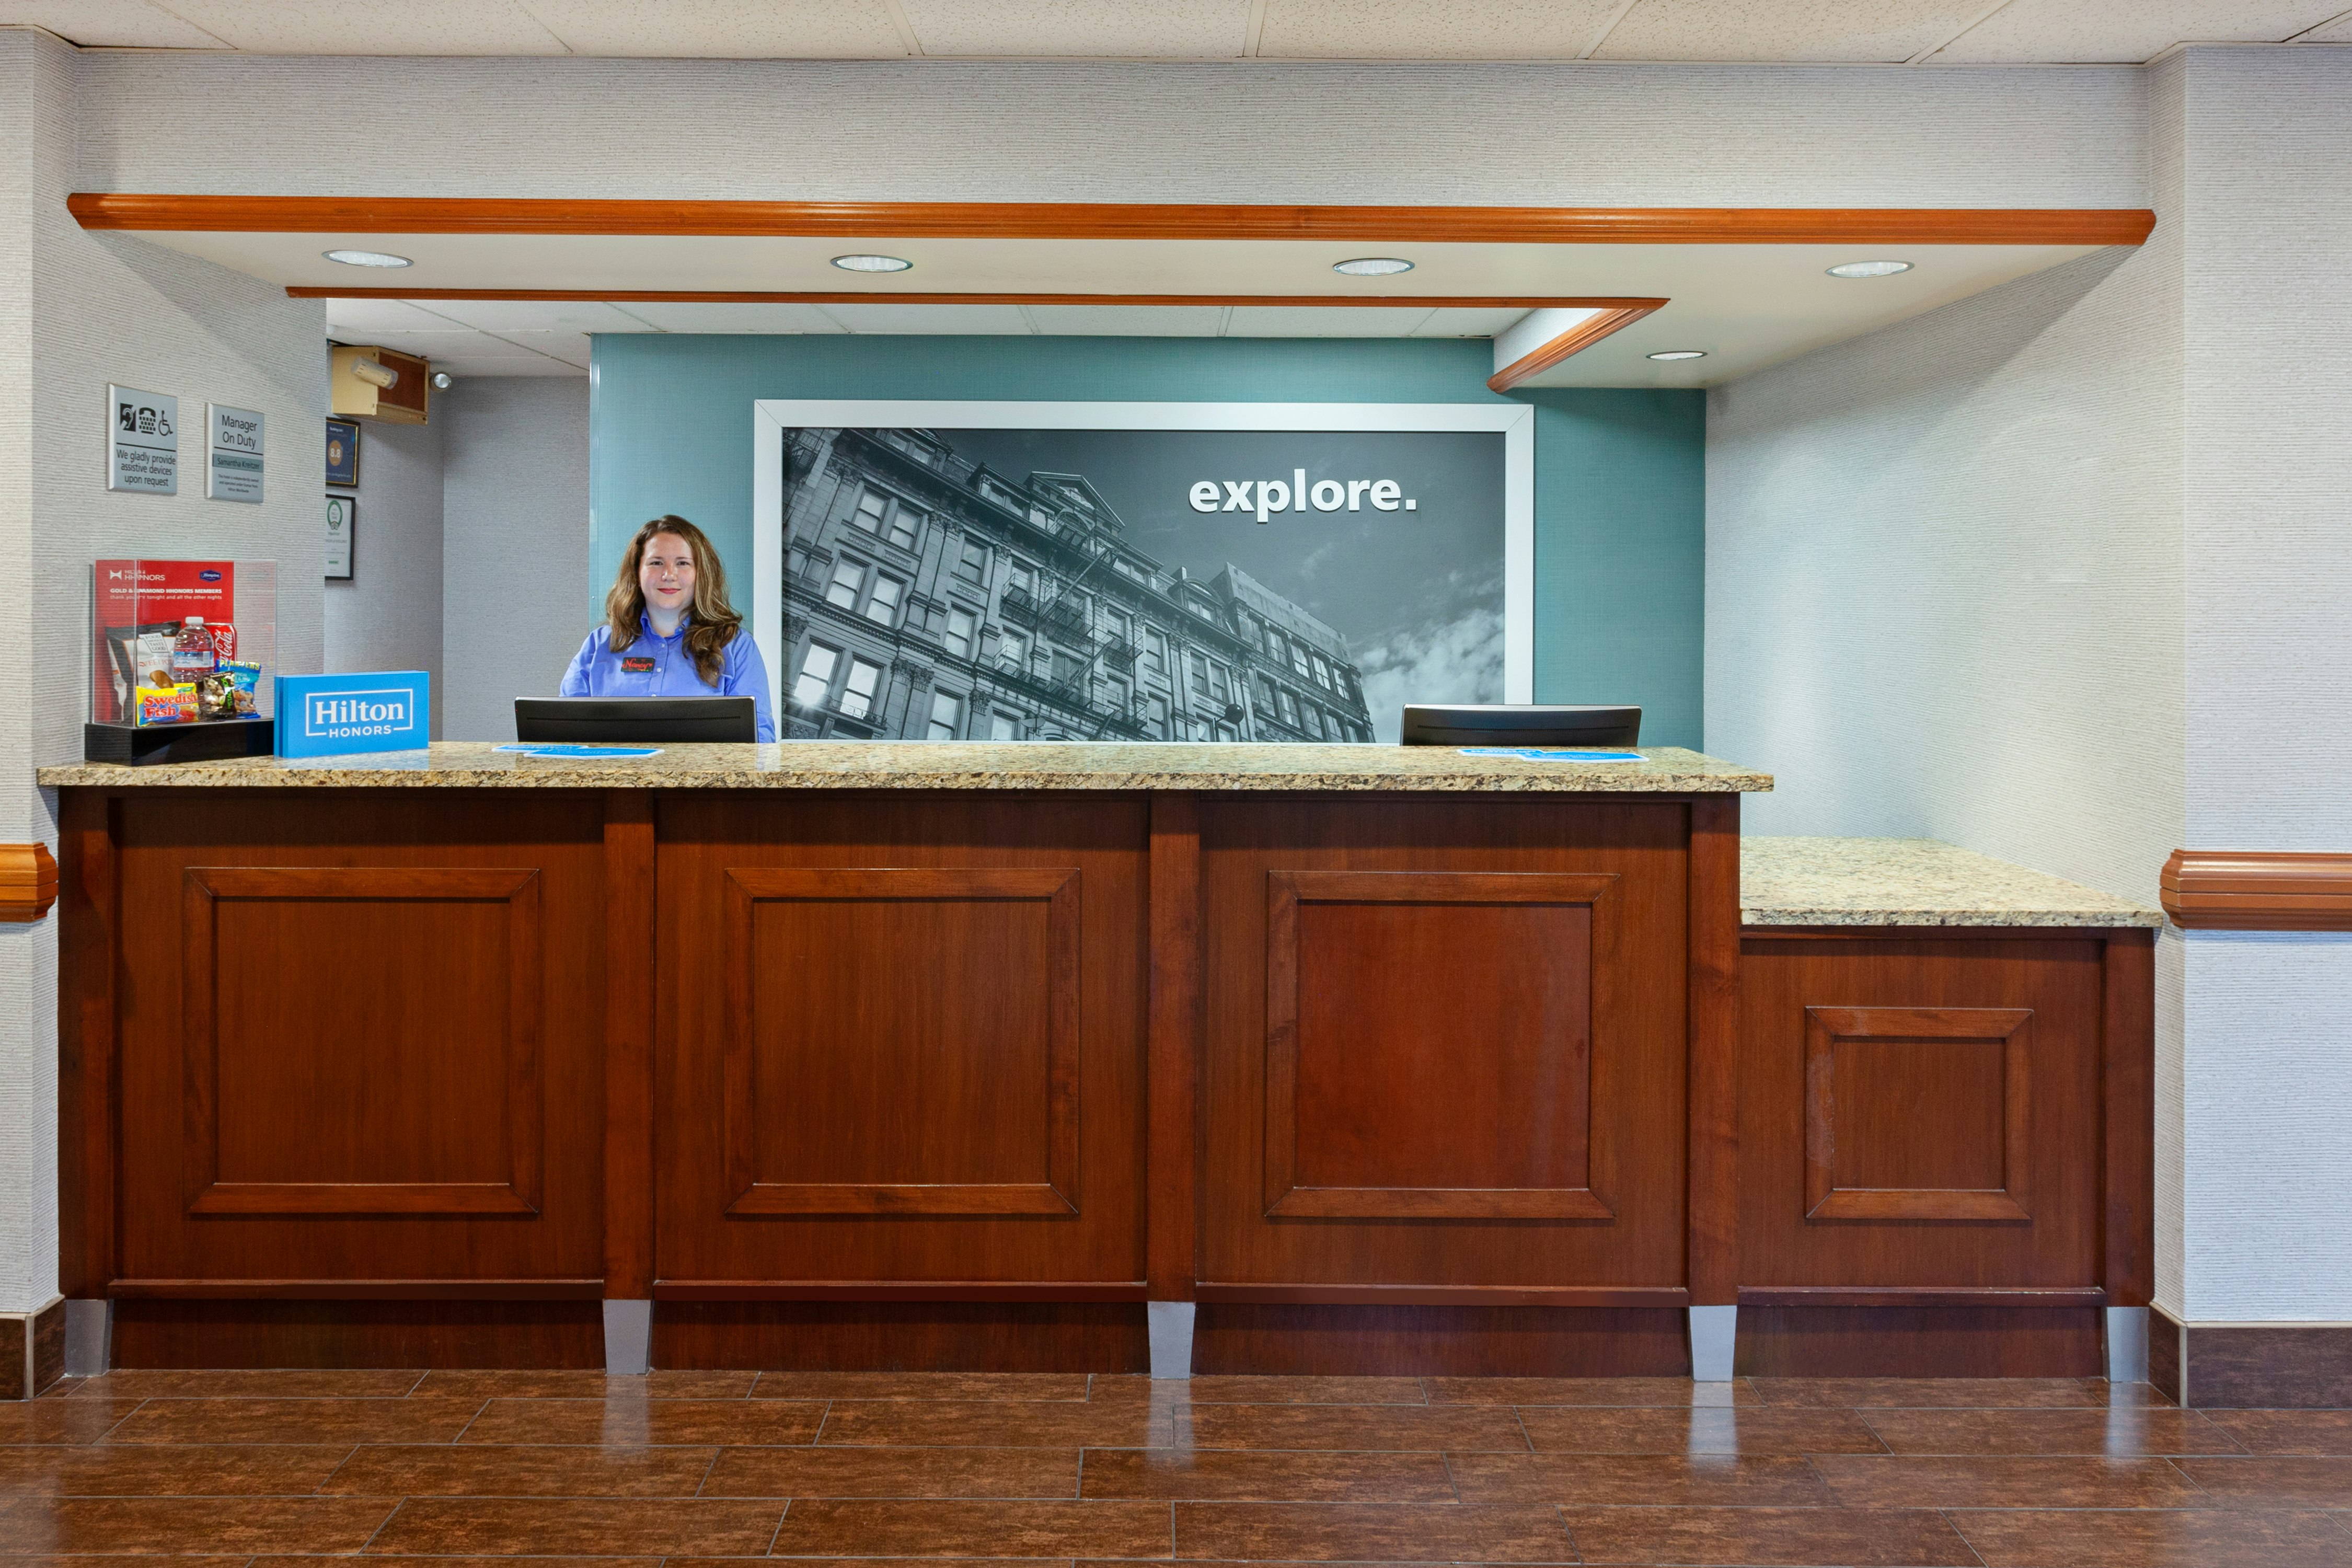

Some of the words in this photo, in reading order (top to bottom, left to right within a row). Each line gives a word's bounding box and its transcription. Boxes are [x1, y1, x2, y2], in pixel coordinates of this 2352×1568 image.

[222, 414, 257, 433] Manager
[223, 431, 234, 444] On
[237, 434, 256, 450] Duty
[117, 449, 128, 459] We
[130, 451, 150, 464] gladly
[153, 455, 176, 466] provide
[330, 448, 340, 458] 8.8
[217, 457, 241, 467] Samantha
[121, 463, 147, 473] assistive
[149, 465, 172, 476] devices
[125, 476, 142, 485] upon
[144, 477, 168, 487] request
[1189, 468, 1416, 523] explore.
[144, 692, 197, 707] Swedish
[144, 706, 177, 718] Fish
[315, 700, 405, 724] Hilton
[329, 725, 391, 738] HONORS
